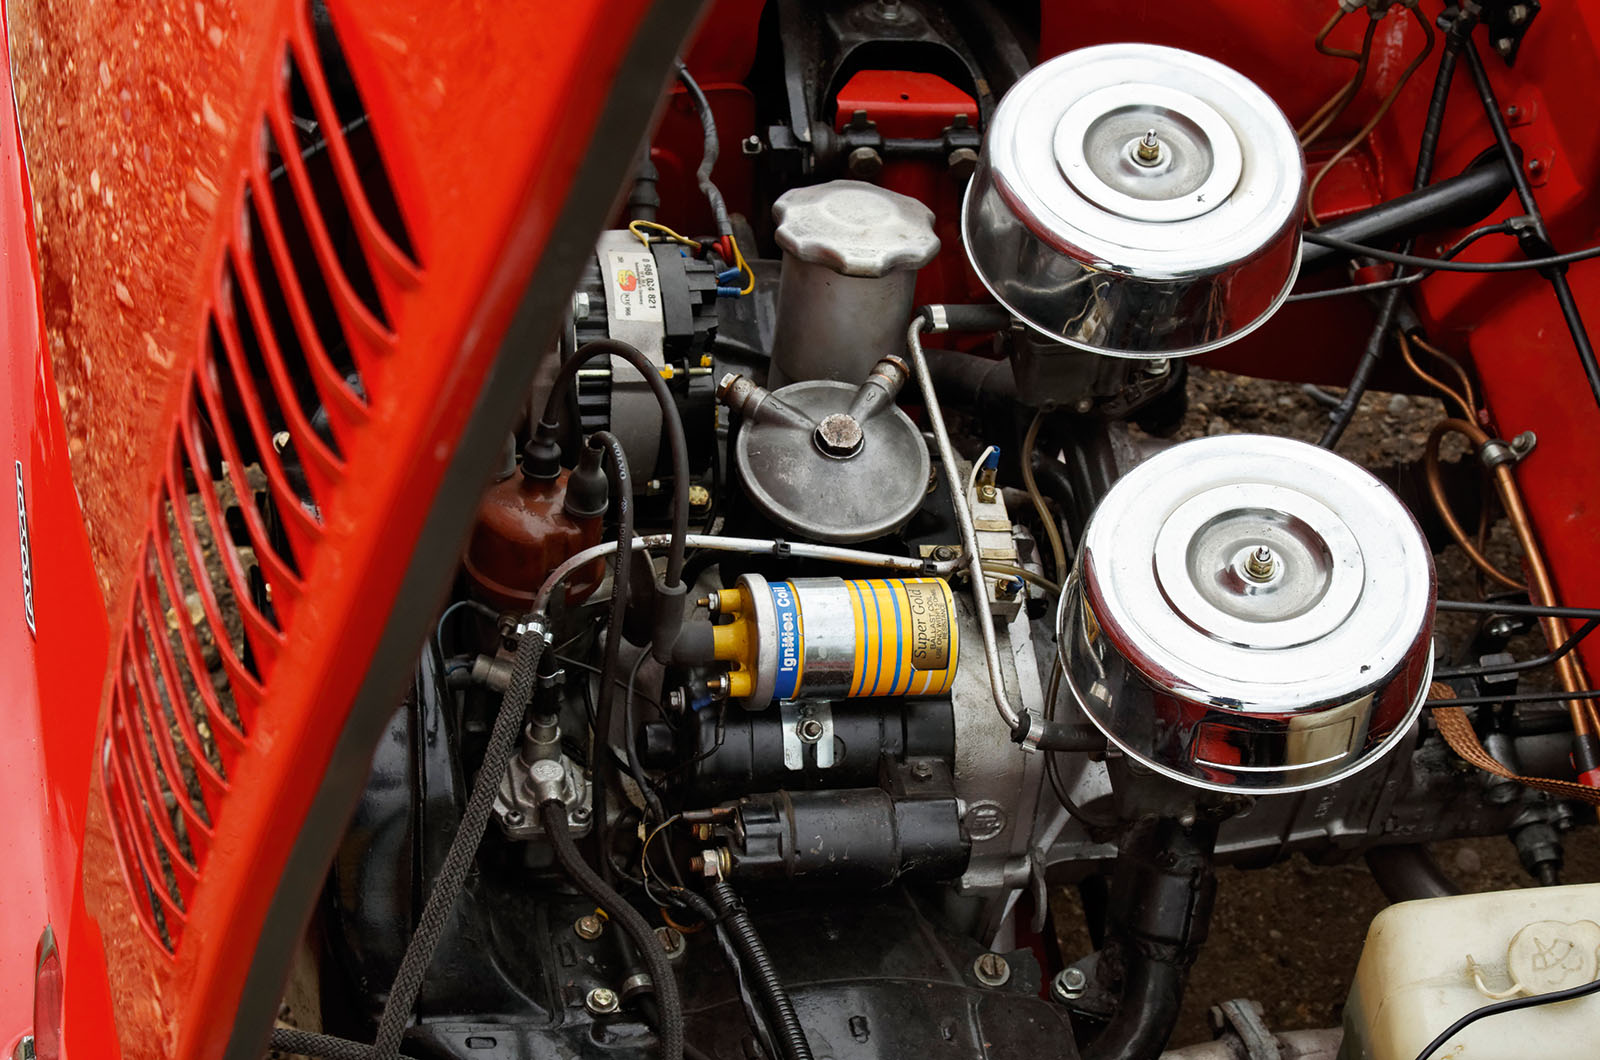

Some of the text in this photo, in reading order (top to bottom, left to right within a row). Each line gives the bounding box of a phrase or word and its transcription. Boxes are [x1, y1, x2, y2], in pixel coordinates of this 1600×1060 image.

[648, 294, 656, 309] 821
[612, 442, 626, 480] VOLVO
[772, 586, 797, 671] Ignition Coil
[908, 589, 930, 659] Super Gold
[929, 613, 937, 650] BALLAST
